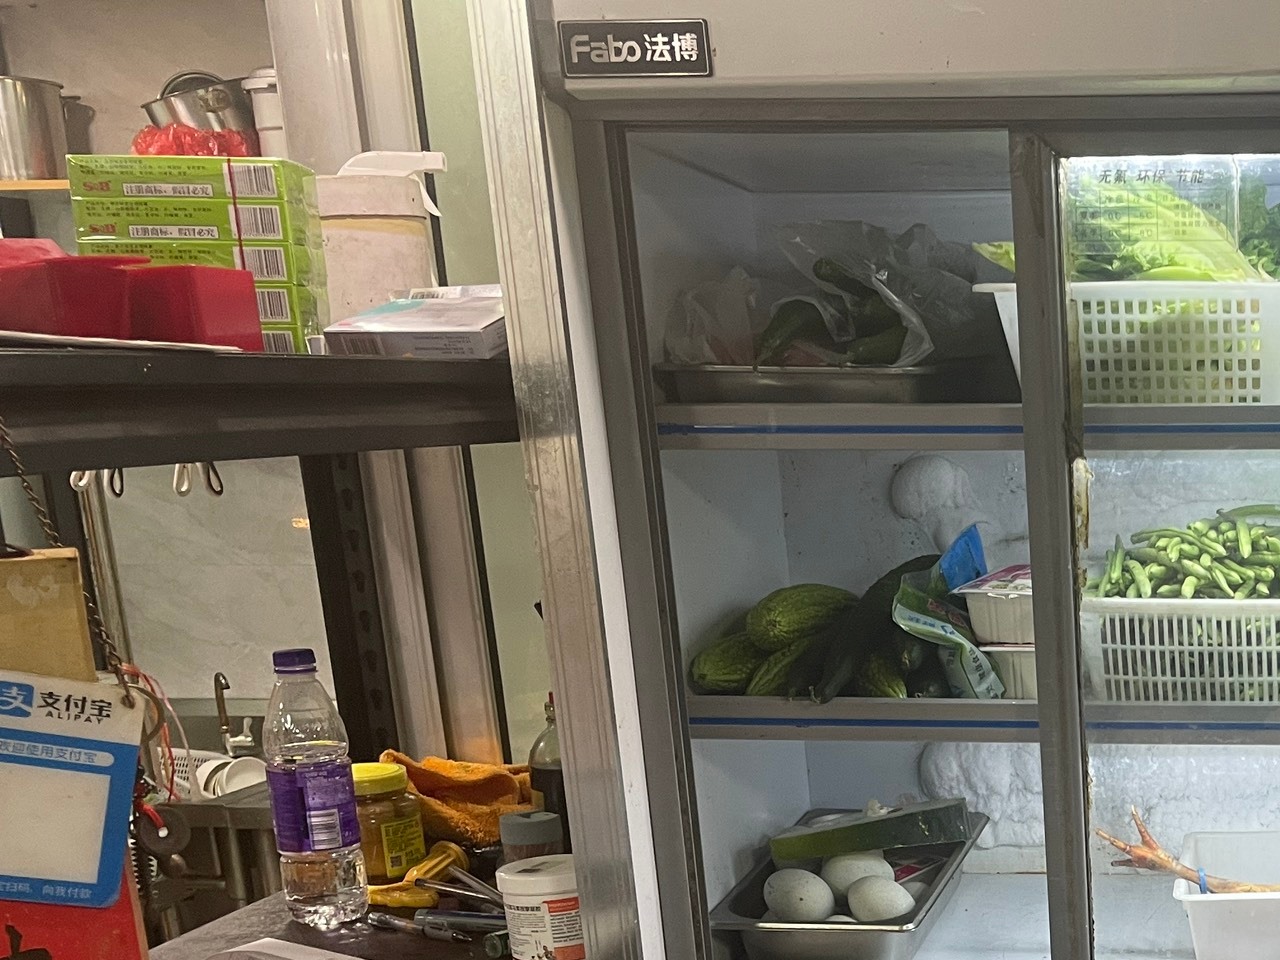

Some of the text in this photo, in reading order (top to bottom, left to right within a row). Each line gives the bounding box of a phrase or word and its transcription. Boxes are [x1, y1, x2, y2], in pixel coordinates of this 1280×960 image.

[570, 33, 699, 63] Fabo 法博
[1099, 168, 1204, 184] 无氟 环保 节能
[37, 691, 112, 718] 支付宝
[45, 710, 104, 724] ALIPAY
